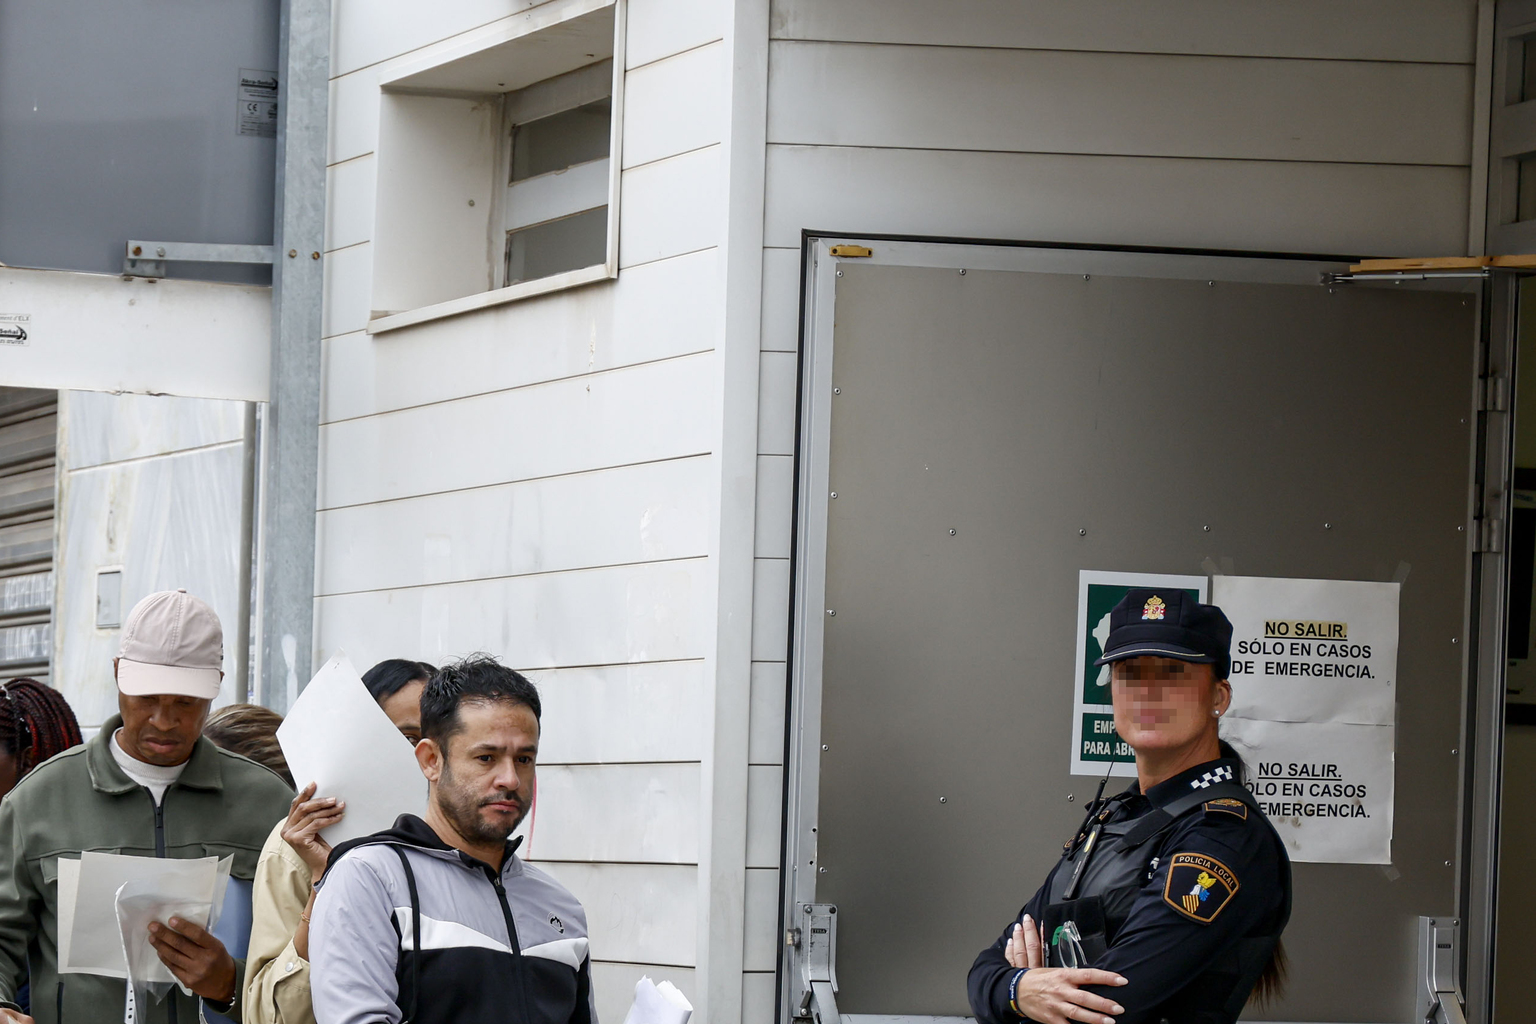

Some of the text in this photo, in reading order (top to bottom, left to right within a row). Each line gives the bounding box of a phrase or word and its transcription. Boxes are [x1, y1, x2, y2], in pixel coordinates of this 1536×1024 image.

[1264, 621, 1347, 638] NO SALIR.
[1238, 638, 1372, 659] SÓLO EN CASOS
[1231, 660, 1376, 679] DE EMERGENCIA.
[1084, 740, 1136, 756] PARA ABR
[1258, 762, 1342, 778] NO SALIR.
[1244, 779, 1367, 798] ÓLO EN CASOS
[1260, 802, 1371, 818] EMERGENCIA.
[1178, 856, 1234, 888] POLICIA LOCAL
